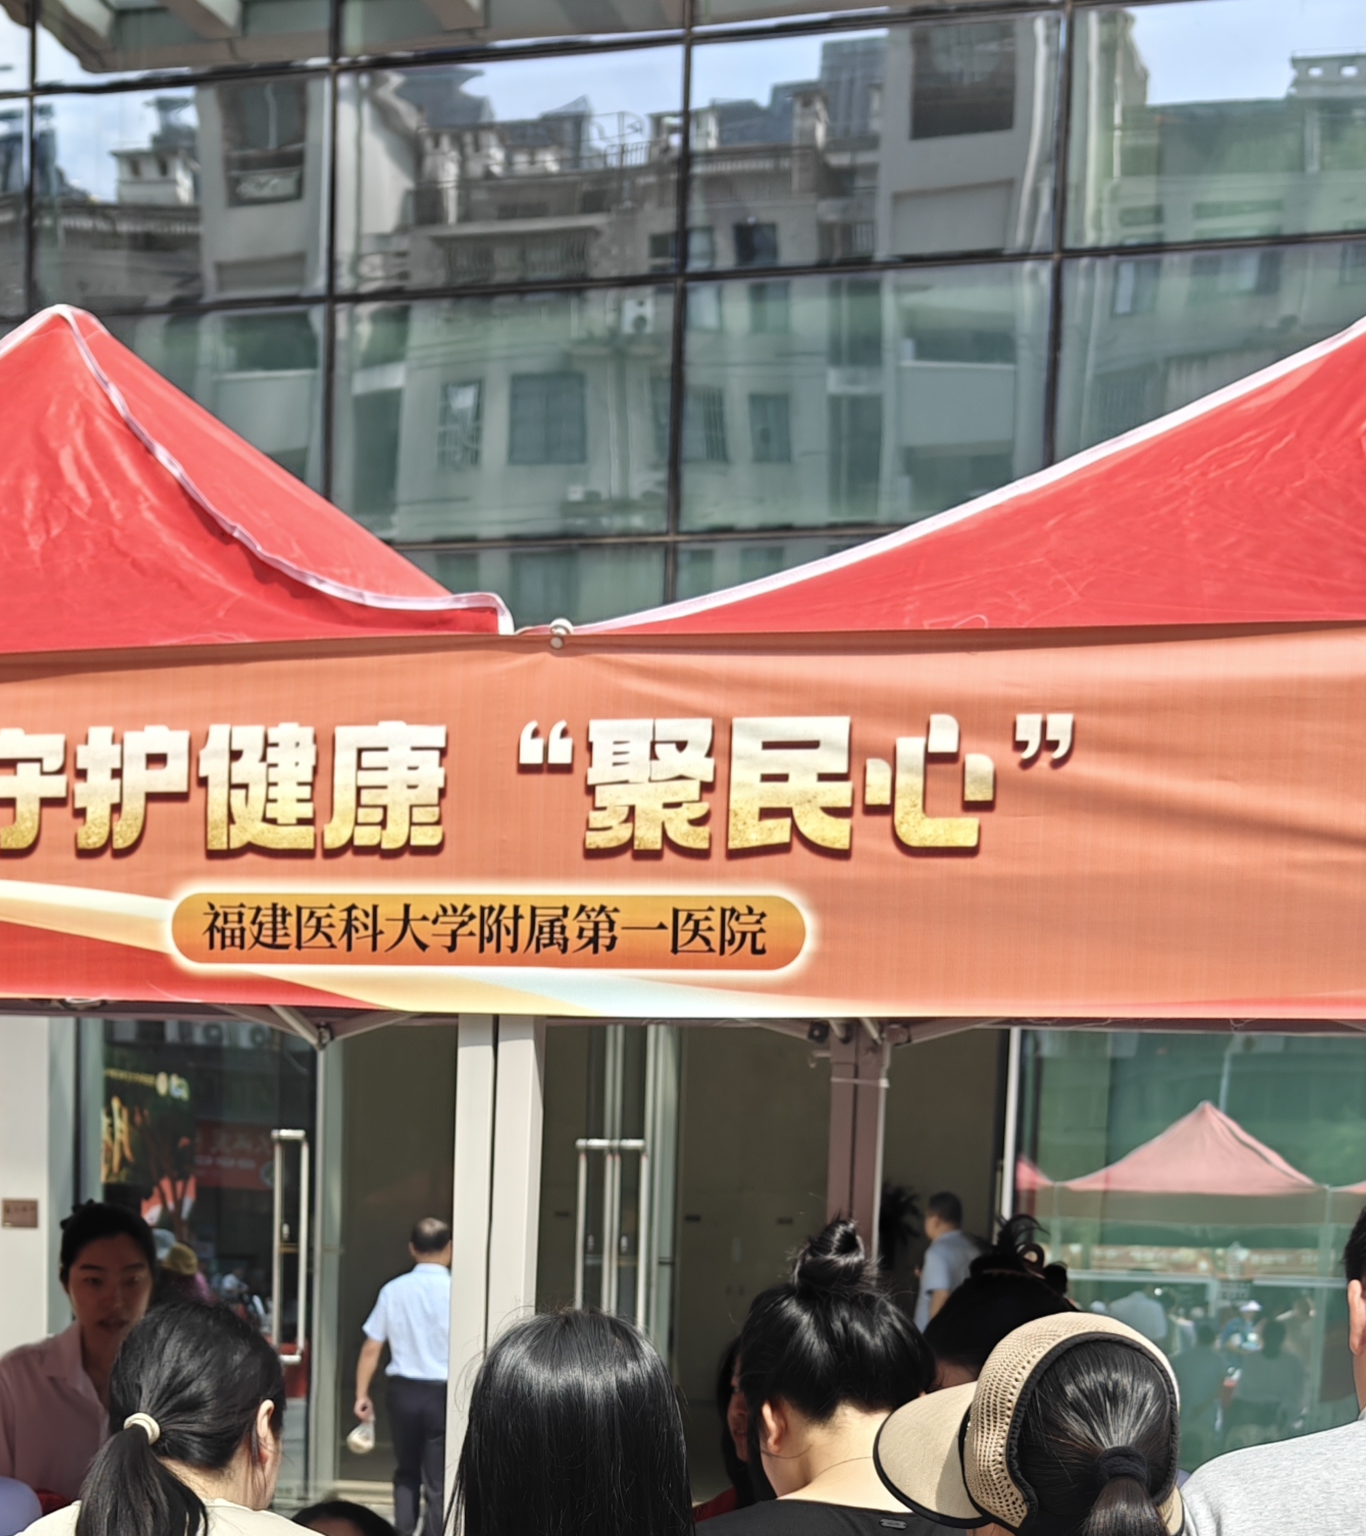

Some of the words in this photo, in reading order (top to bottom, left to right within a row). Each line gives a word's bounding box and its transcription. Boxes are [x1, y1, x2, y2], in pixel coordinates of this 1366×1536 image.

[517, 711, 1077, 862] “聚民心”
[201, 900, 768, 958] 福建医科大学附属第一医院
